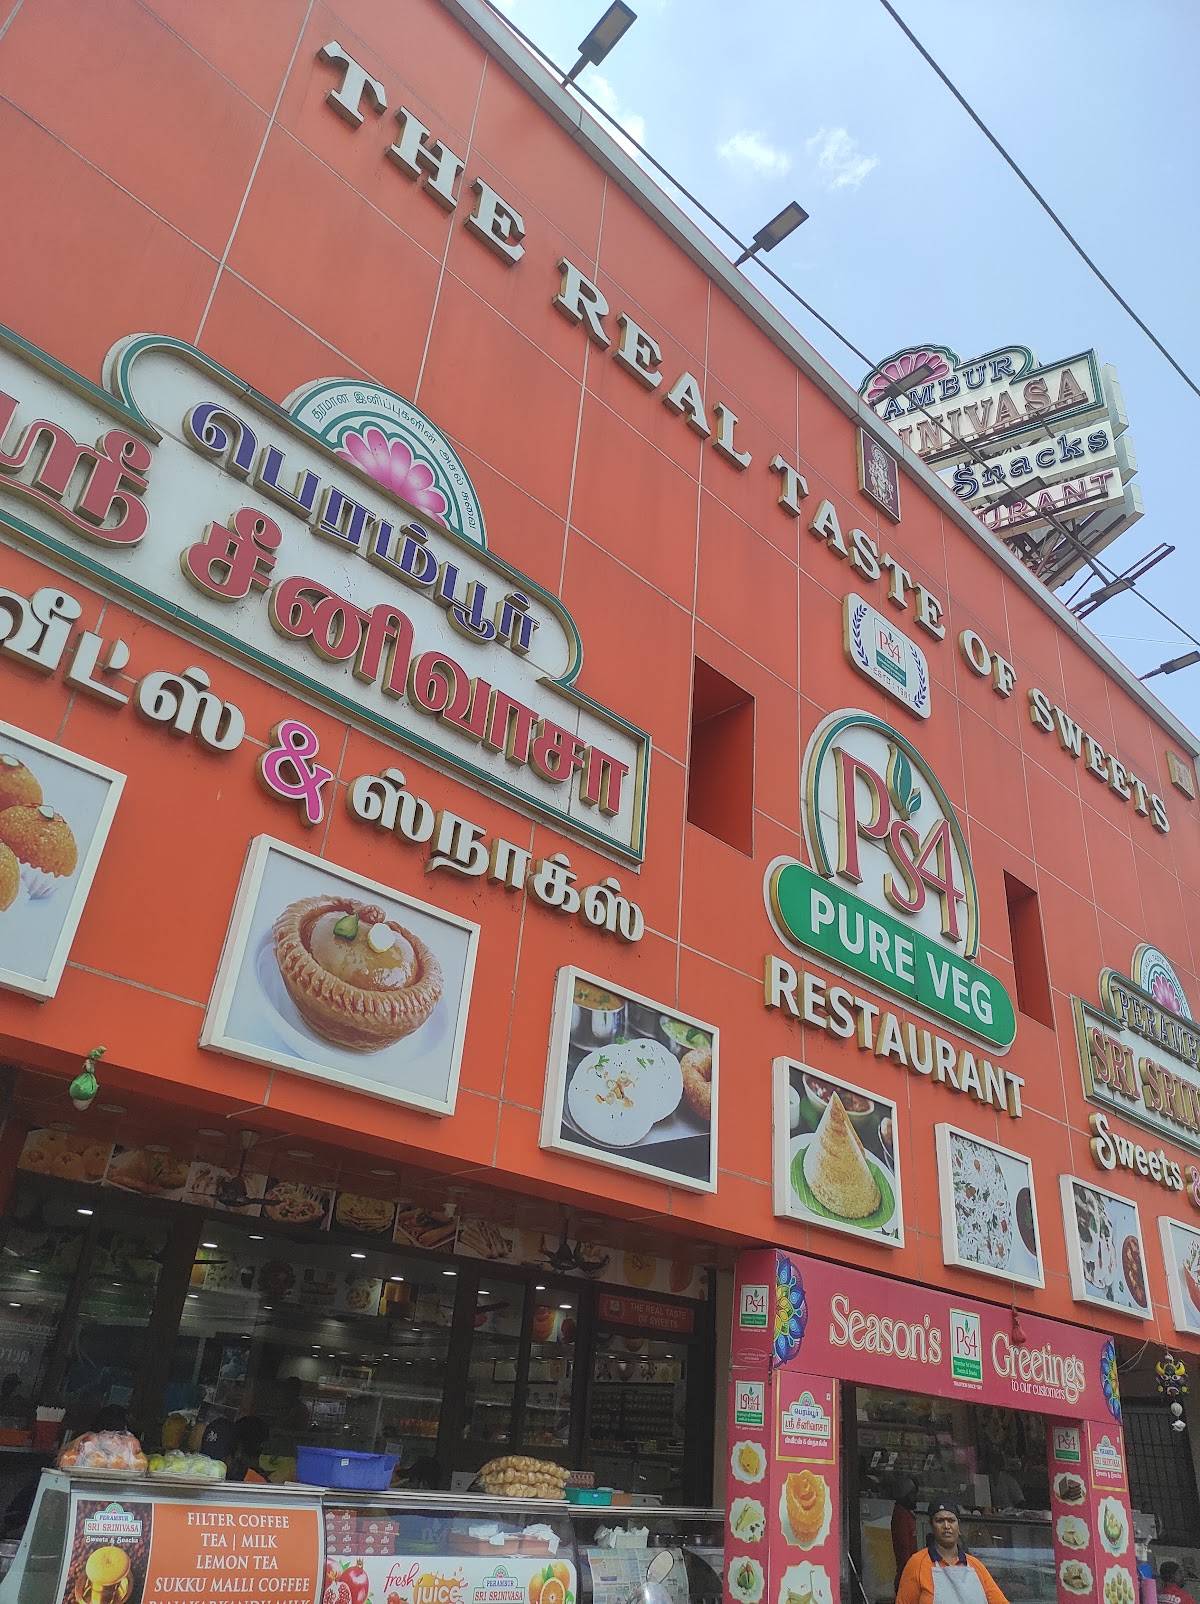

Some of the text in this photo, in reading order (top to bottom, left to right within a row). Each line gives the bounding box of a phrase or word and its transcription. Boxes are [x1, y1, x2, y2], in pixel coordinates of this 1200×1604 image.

[312, 394, 350, 423] தரமான
[354, 391, 437, 444] இனிப்புகளின்
[883, 354, 1016, 420] AMBUR
[318, 41, 1171, 834] THE REAL TASTE OF SWEETS
[952, 430, 1108, 499] Snacks
[184, 401, 540, 655] பெரம்பூர்
[181, 507, 630, 815] சீனிவாசா
[257, 718, 334, 826] &
[347, 767, 645, 943] ஸ்நாக்ஸ்
[834, 747, 966, 942] PS4
[810, 887, 994, 1025] PURE VEG
[765, 955, 1024, 1118] RESTAURANT
[1114, 985, 1200, 1064] PERAMB
[1087, 1026, 1140, 1100] SRI
[1089, 1112, 1184, 1191] Sweets
[829, 1293, 1085, 1404] Season's Greetings
[1011, 1379, 1066, 1399] to our customers
[87, 1523, 139, 1532] SRI SRINIVASA
[187, 1512, 289, 1529] FILTER COFFEE
[201, 1534, 228, 1548] TEA
[241, 1535, 278, 1549] MILK
[154, 1577, 310, 1592] SUKKU MALLI COFFEE
[196, 1555, 278, 1570] LEMON TEA
[384, 1562, 419, 1593] fresh
[475, 1591, 523, 1600] SRI SRINIVASA
